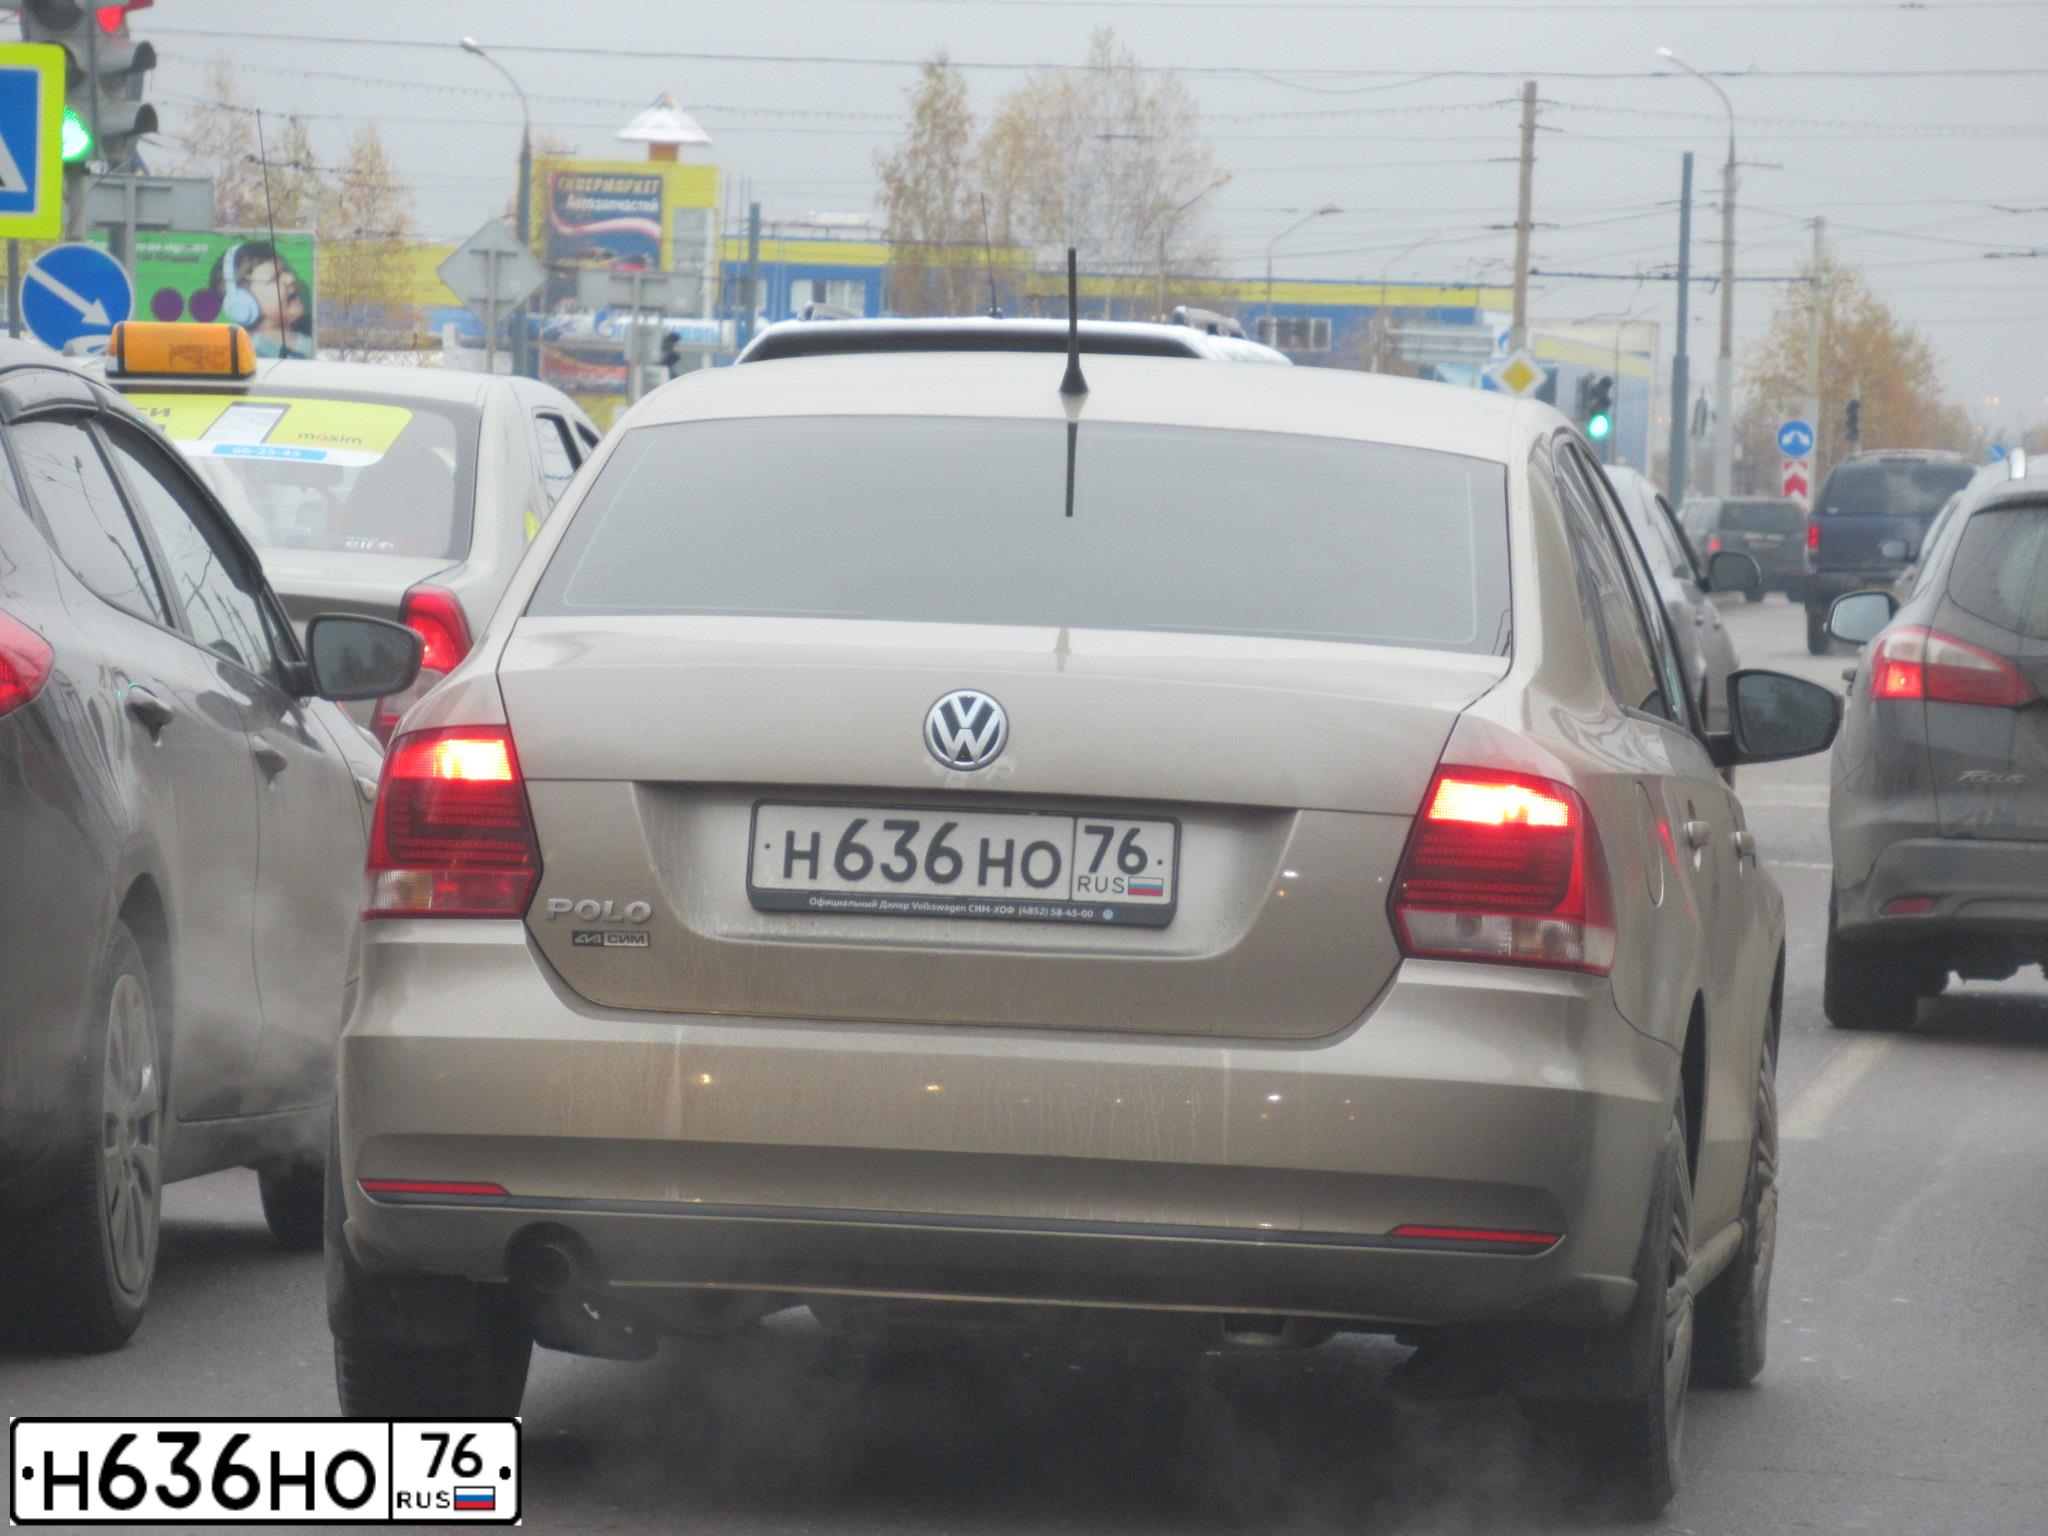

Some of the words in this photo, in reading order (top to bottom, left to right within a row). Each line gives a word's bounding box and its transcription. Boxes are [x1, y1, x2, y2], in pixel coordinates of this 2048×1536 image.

[298, 432, 363, 445] maxim
[1084, 824, 1149, 876] 76
[1078, 876, 1125, 895] RUS
[546, 898, 652, 922] POLO
[808, 897, 878, 910] Официальный
[880, 899, 911, 912] Дилер
[912, 901, 967, 914] Volkswagen
[606, 933, 645, 945] СИМ
